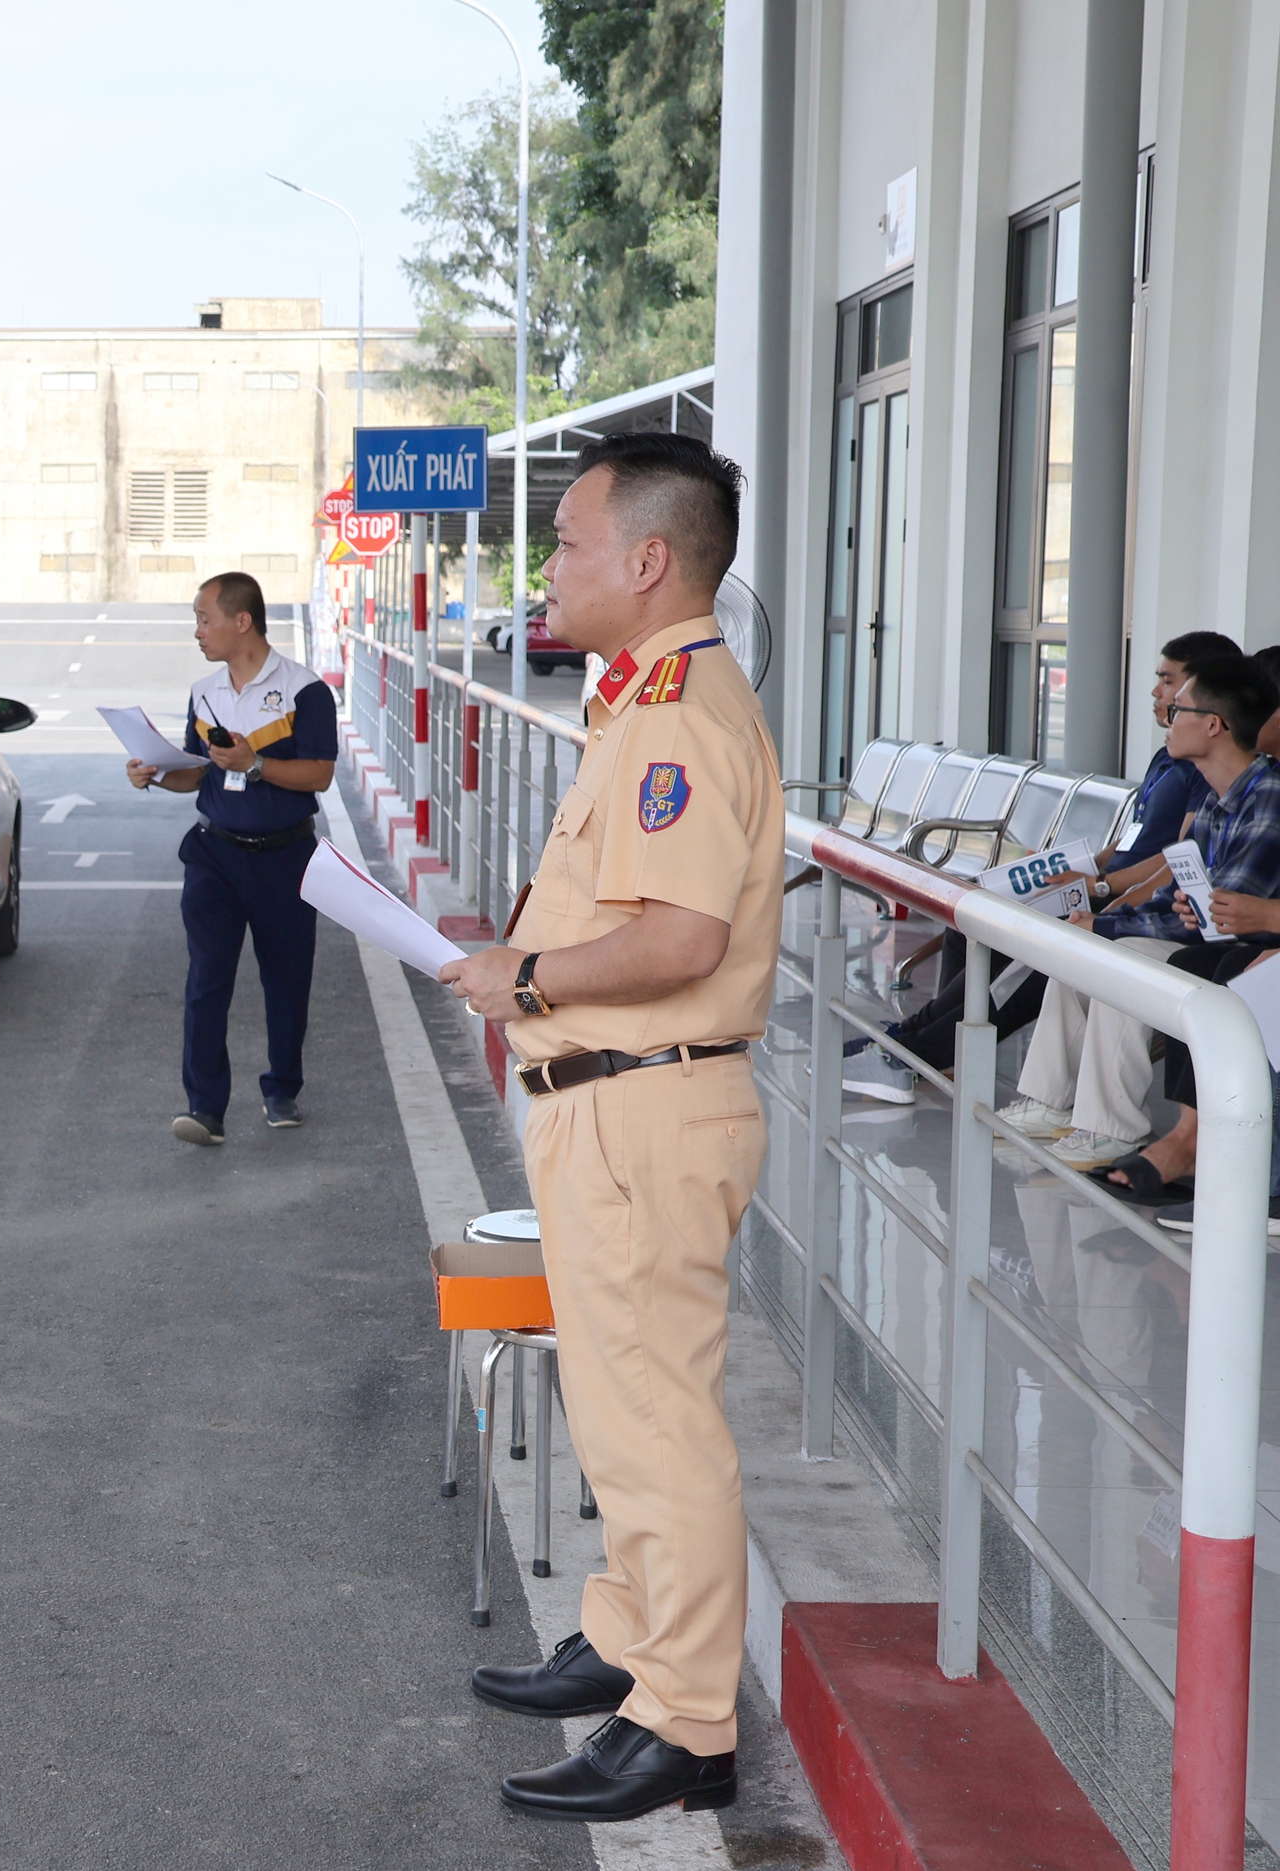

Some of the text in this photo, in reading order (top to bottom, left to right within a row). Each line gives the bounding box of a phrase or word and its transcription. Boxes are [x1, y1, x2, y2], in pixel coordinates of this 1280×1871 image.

[366, 440, 477, 492] XUẤT PHÁT
[346, 516, 393, 539] STOP
[644, 799, 675, 812] CS GT
[1008, 852, 1071, 895] 086
